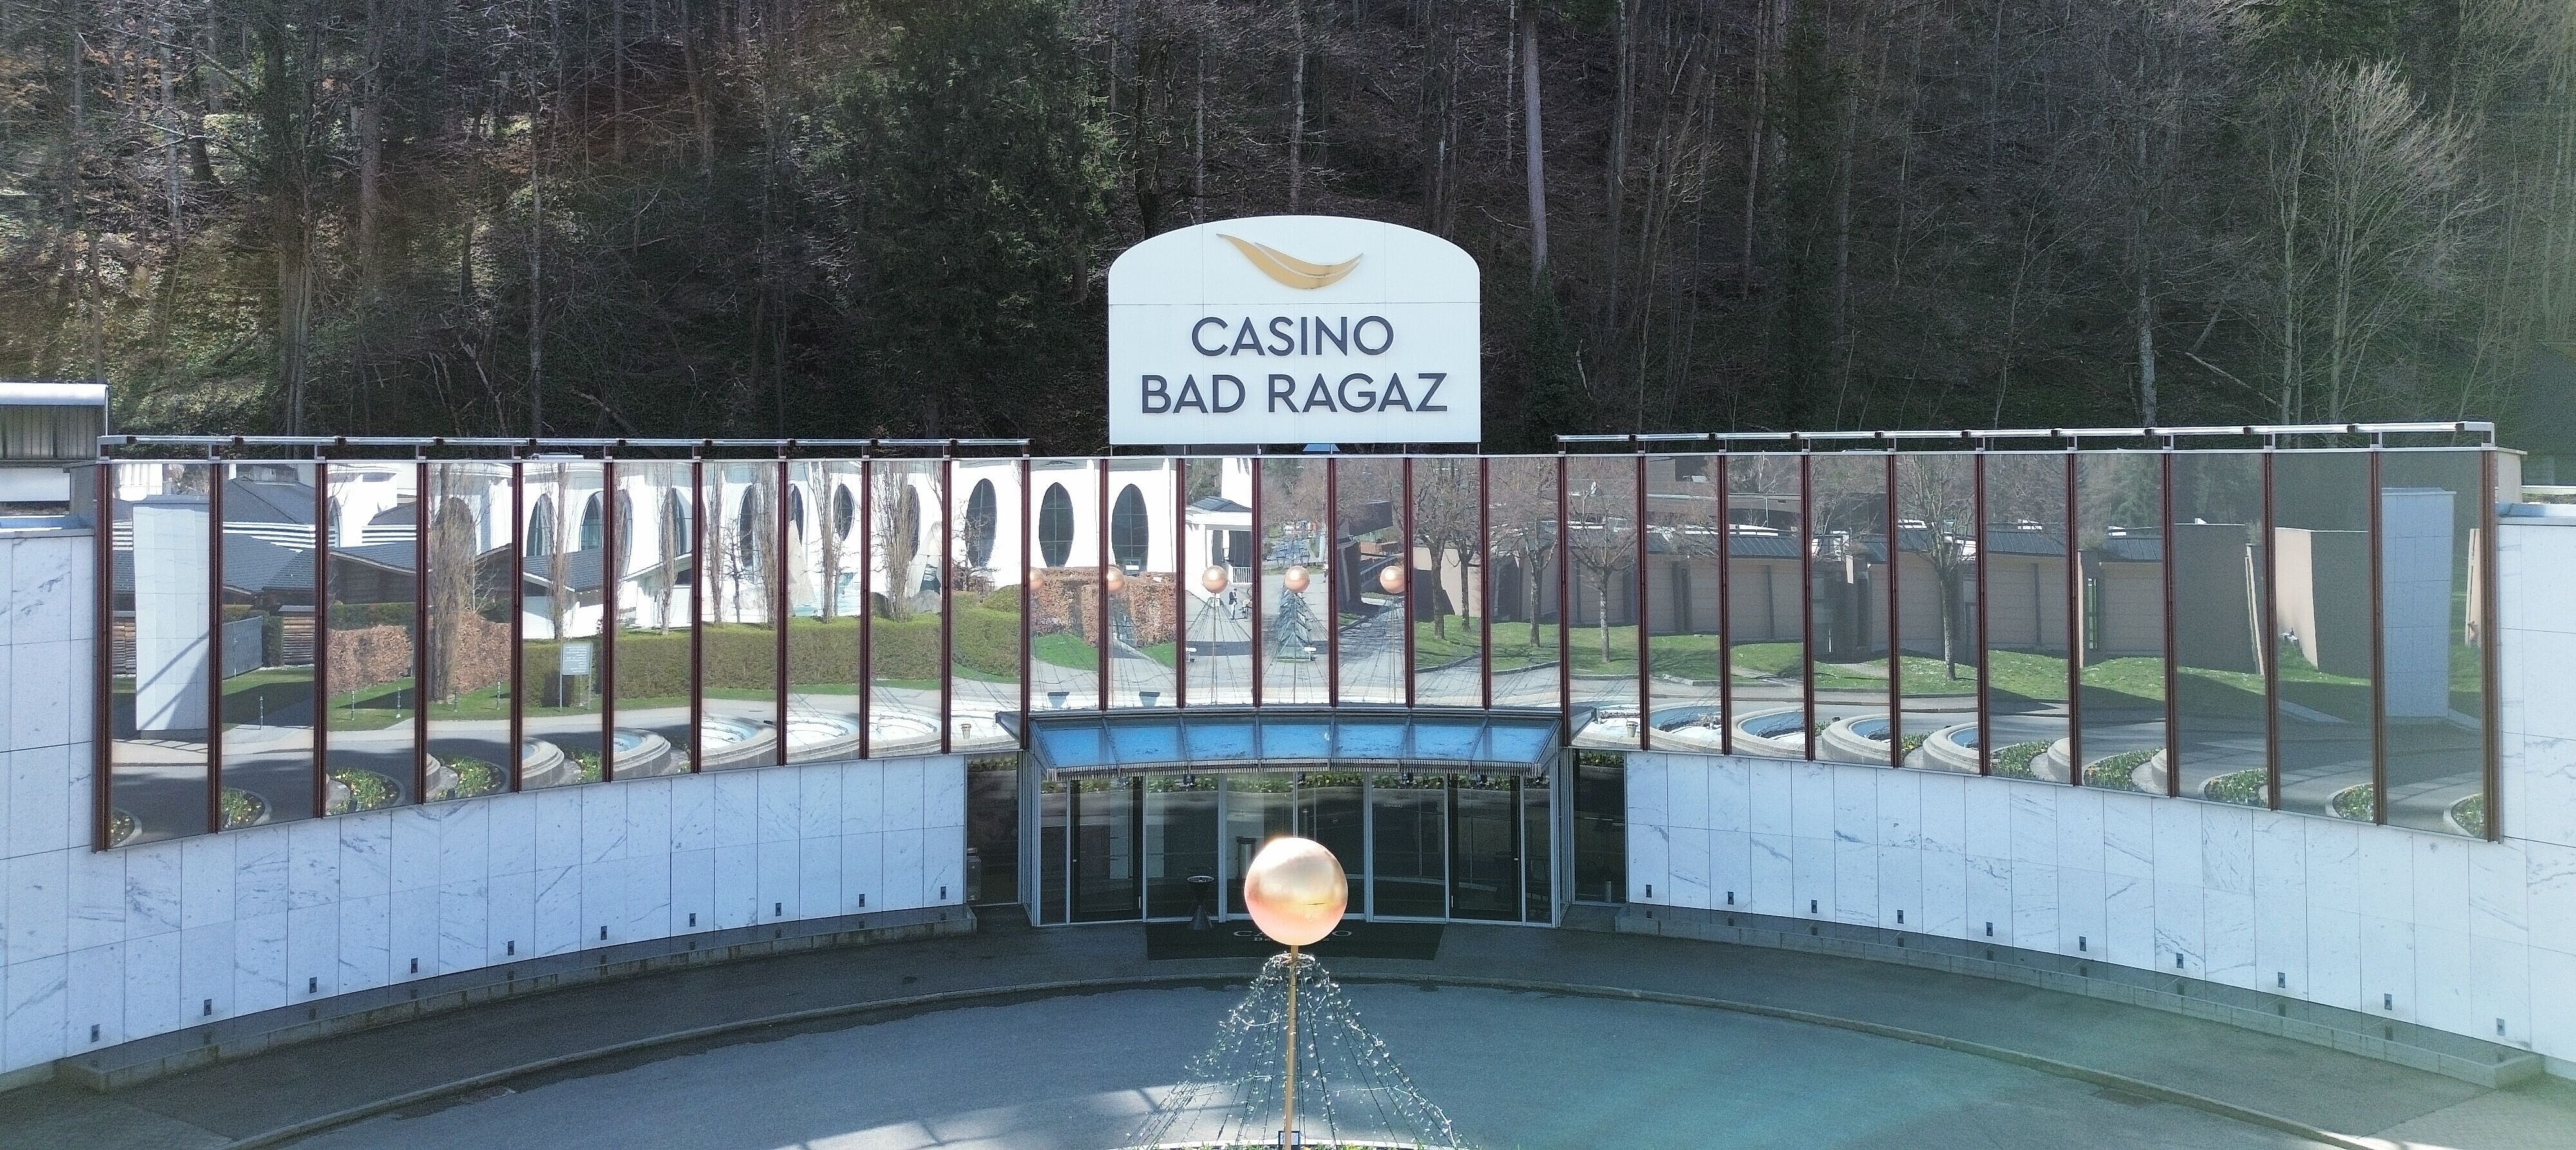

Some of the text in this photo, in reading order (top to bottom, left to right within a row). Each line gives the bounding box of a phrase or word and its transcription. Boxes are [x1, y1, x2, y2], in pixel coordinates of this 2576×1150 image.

[1191, 316, 1394, 357] CASINO
[1142, 372, 1448, 414] BAD RAGAZ
